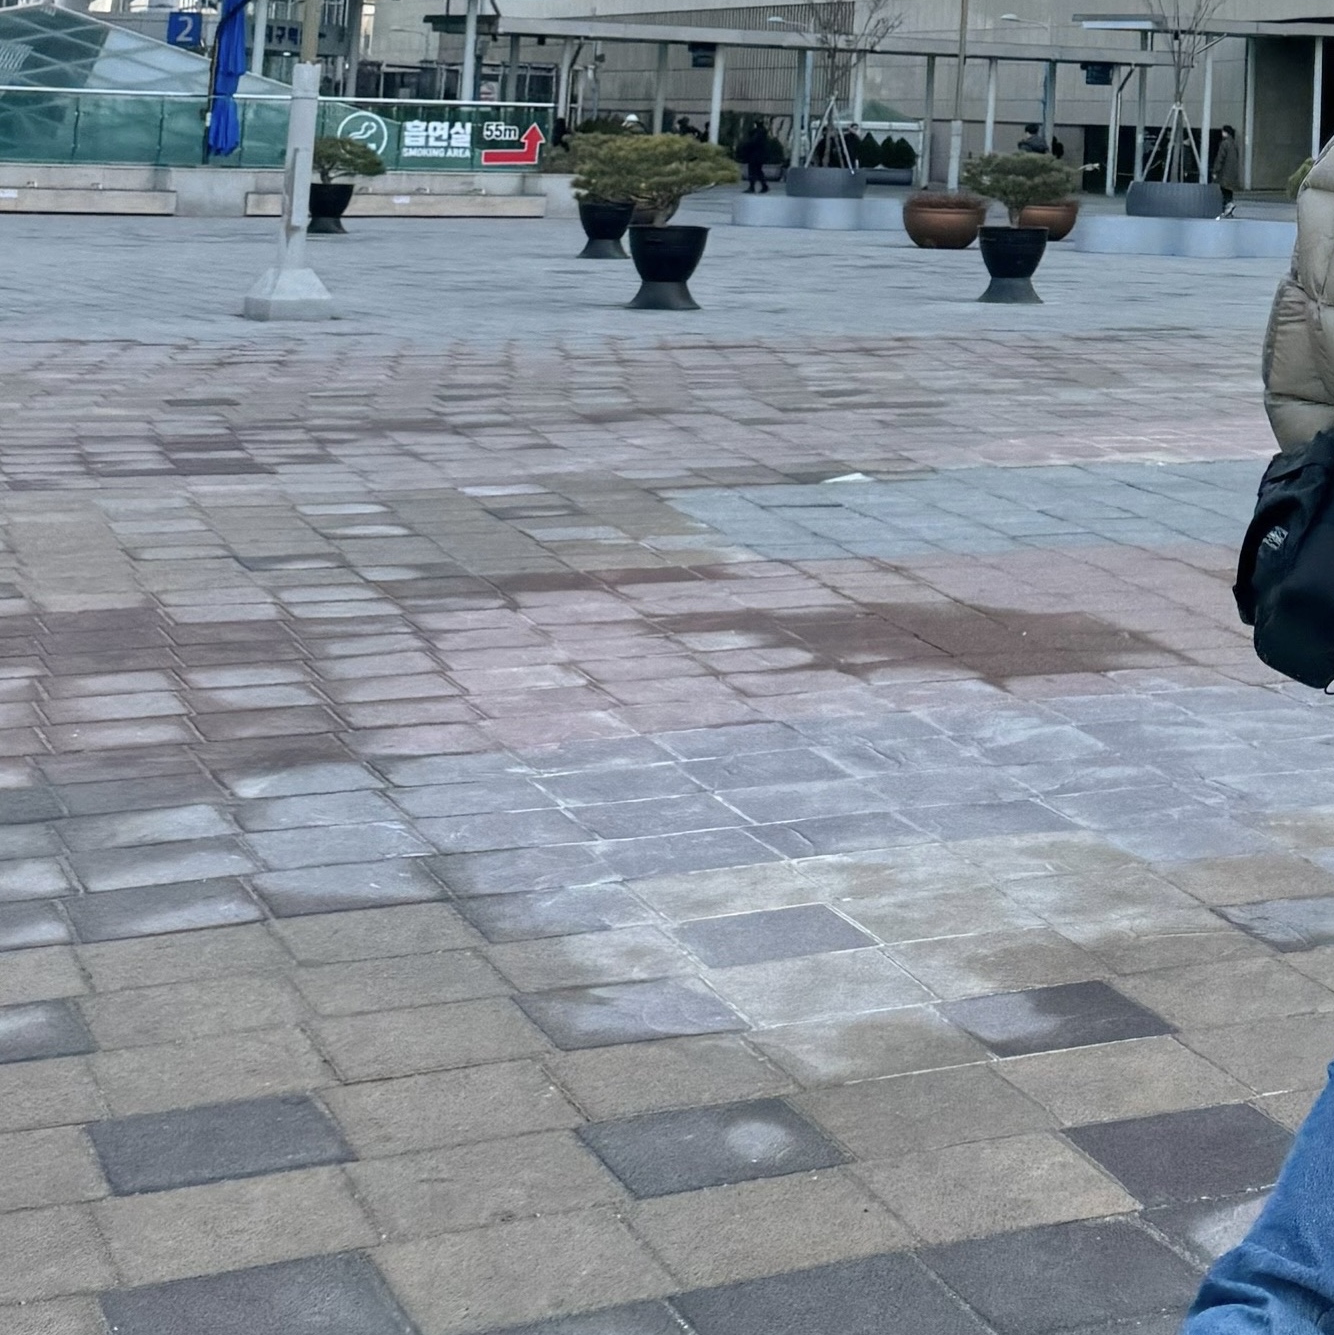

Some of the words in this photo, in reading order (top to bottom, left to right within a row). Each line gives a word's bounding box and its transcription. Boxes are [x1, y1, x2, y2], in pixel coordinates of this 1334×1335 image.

[176, 16, 194, 42] 2
[404, 120, 472, 147] 흡연실
[484, 122, 519, 140] 55m
[402, 147, 444, 158] SMOKING
[446, 147, 471, 158] AREA
